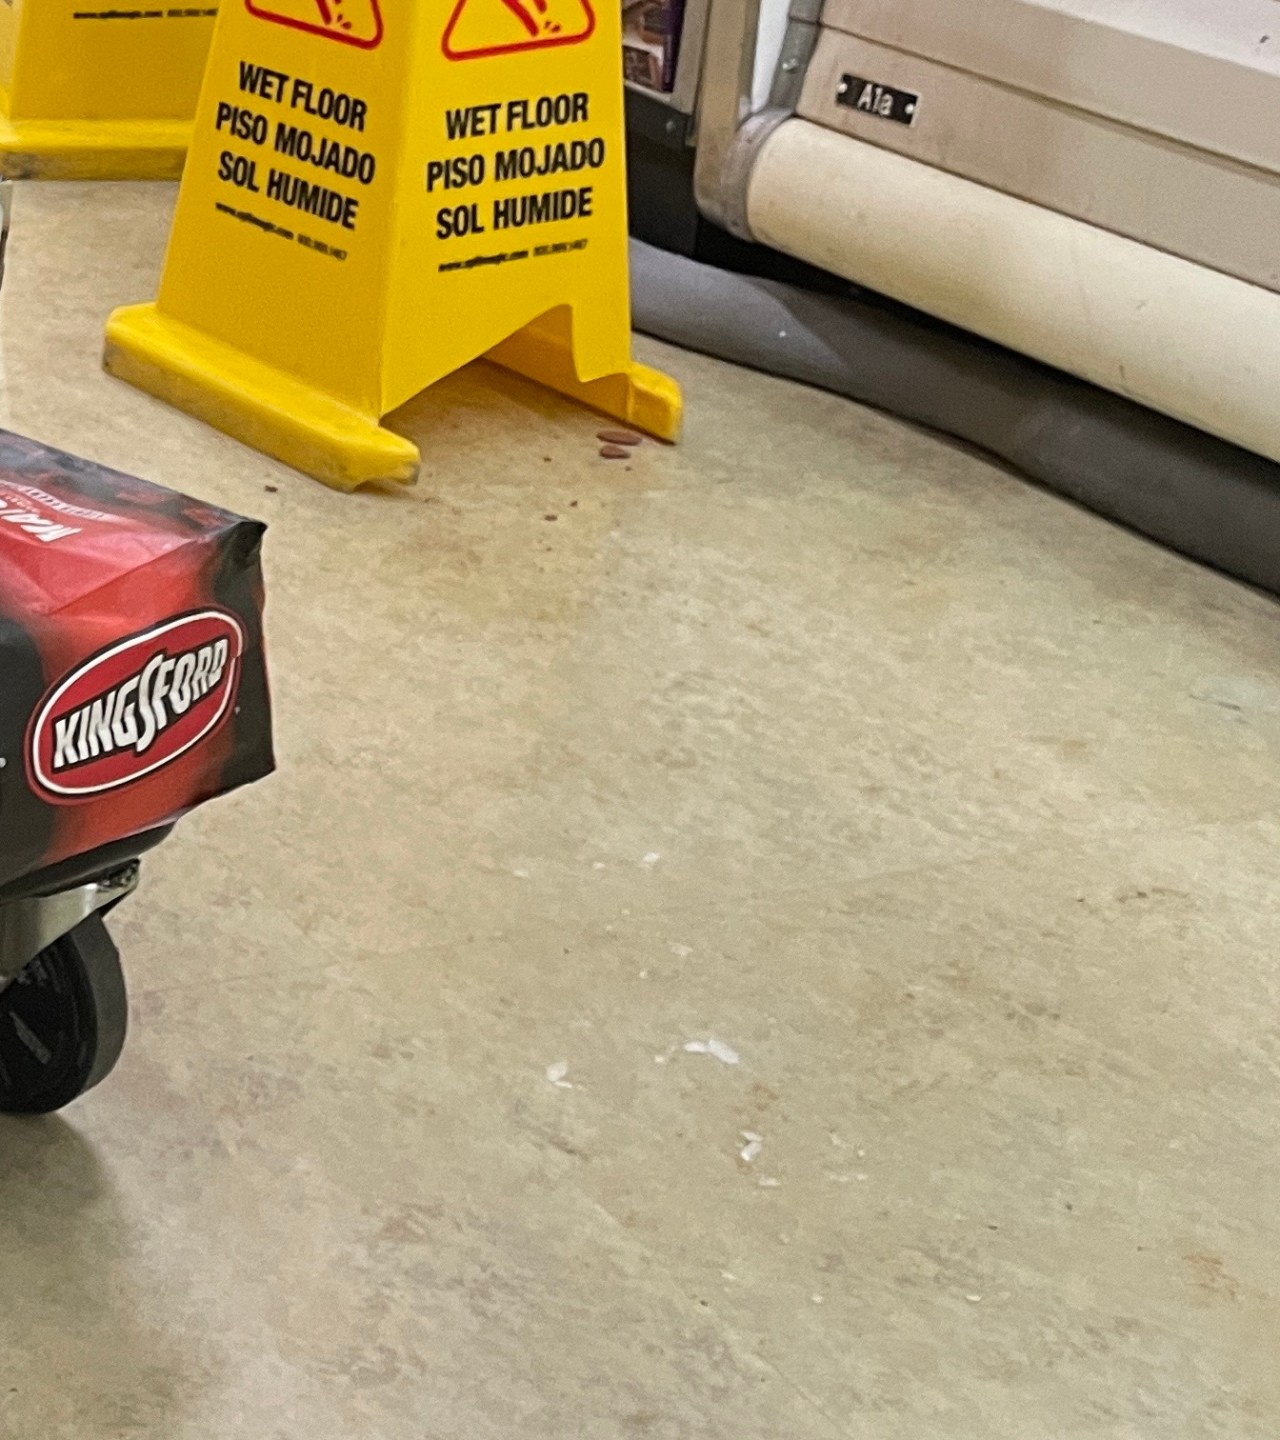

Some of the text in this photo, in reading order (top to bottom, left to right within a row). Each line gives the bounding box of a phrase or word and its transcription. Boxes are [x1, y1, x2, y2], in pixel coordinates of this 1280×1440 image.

[237, 60, 368, 133] WET FLOOR
[445, 92, 590, 141] WET FLOOR
[215, 101, 377, 187] PISO MOJADO
[425, 137, 607, 192] PISO MOJADO
[217, 150, 260, 194] SOL
[264, 170, 359, 231] HUMIDE
[434, 187, 593, 240] SOL HUMIDE
[52, 634, 234, 772] KINGSFORD
